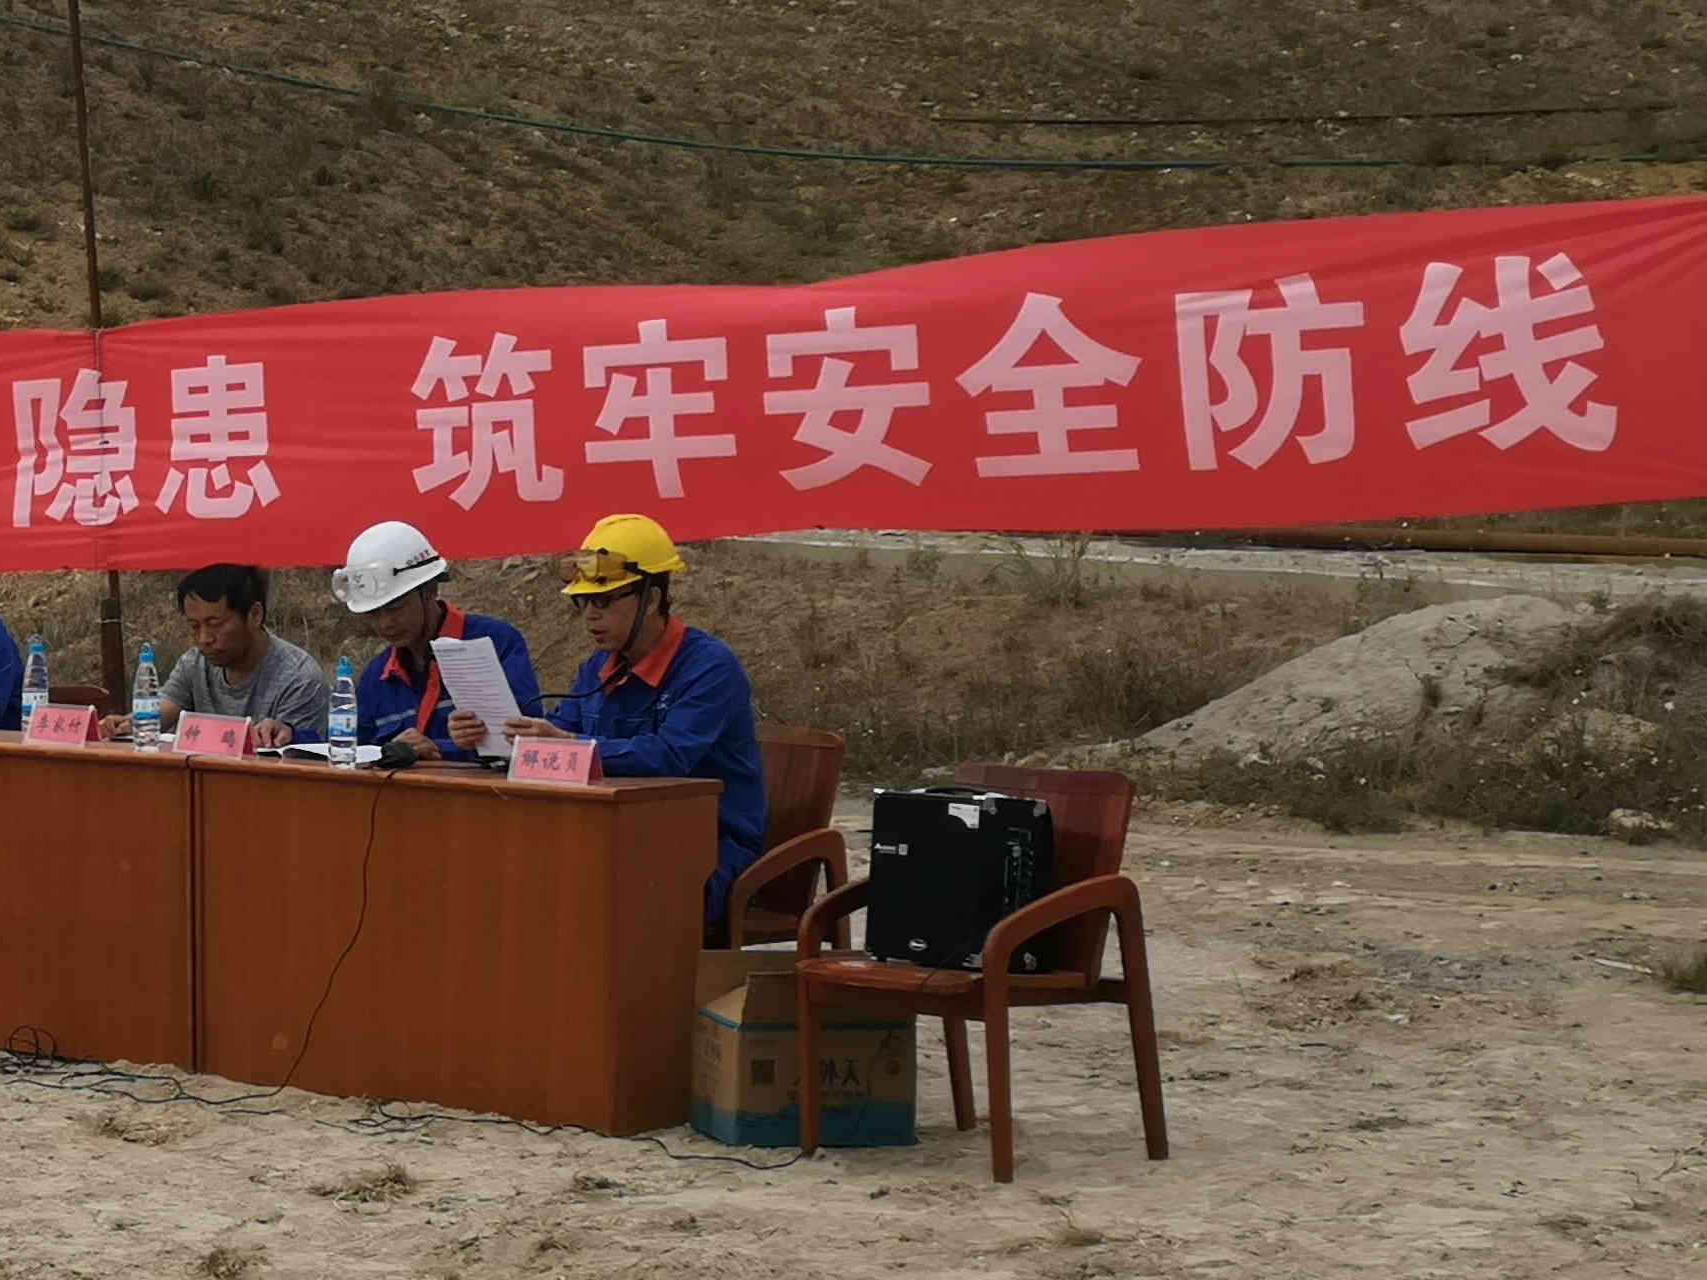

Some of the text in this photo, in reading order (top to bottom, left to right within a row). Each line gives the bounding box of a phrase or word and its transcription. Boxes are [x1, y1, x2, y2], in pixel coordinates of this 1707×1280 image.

[411, 252, 1618, 511] 筑牢安全防线
[520, 748, 580, 773] 解说员
